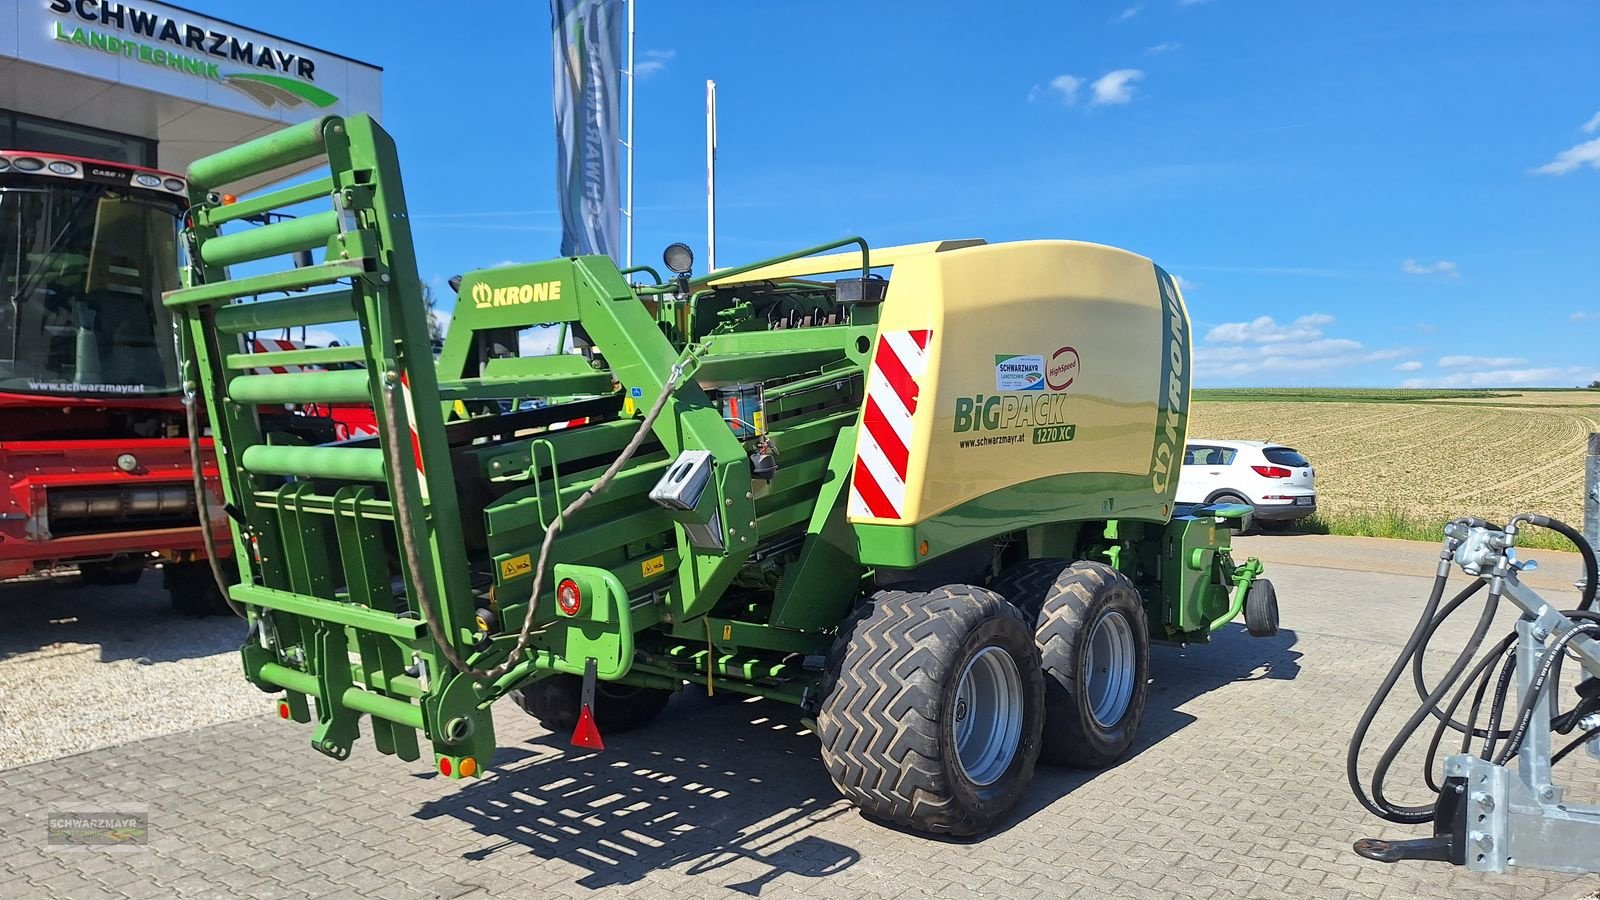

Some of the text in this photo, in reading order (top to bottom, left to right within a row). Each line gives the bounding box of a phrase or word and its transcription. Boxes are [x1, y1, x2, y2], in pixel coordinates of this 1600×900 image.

[49, 0, 316, 81] SCHWARZMAYR
[54, 20, 220, 80] LANDTECHNIK
[92, 168, 117, 177] CASE
[493, 280, 561, 307] KRONE
[999, 364, 1039, 373] SCHWARZMAYR
[1049, 360, 1077, 377] HighSpeed
[1161, 274, 1184, 446] KRONE
[28, 381, 145, 395] www.schwarzmayr.at
[959, 433, 1025, 449] www.schwarzmayr.at
[1037, 426, 1072, 443] 1270 XC
